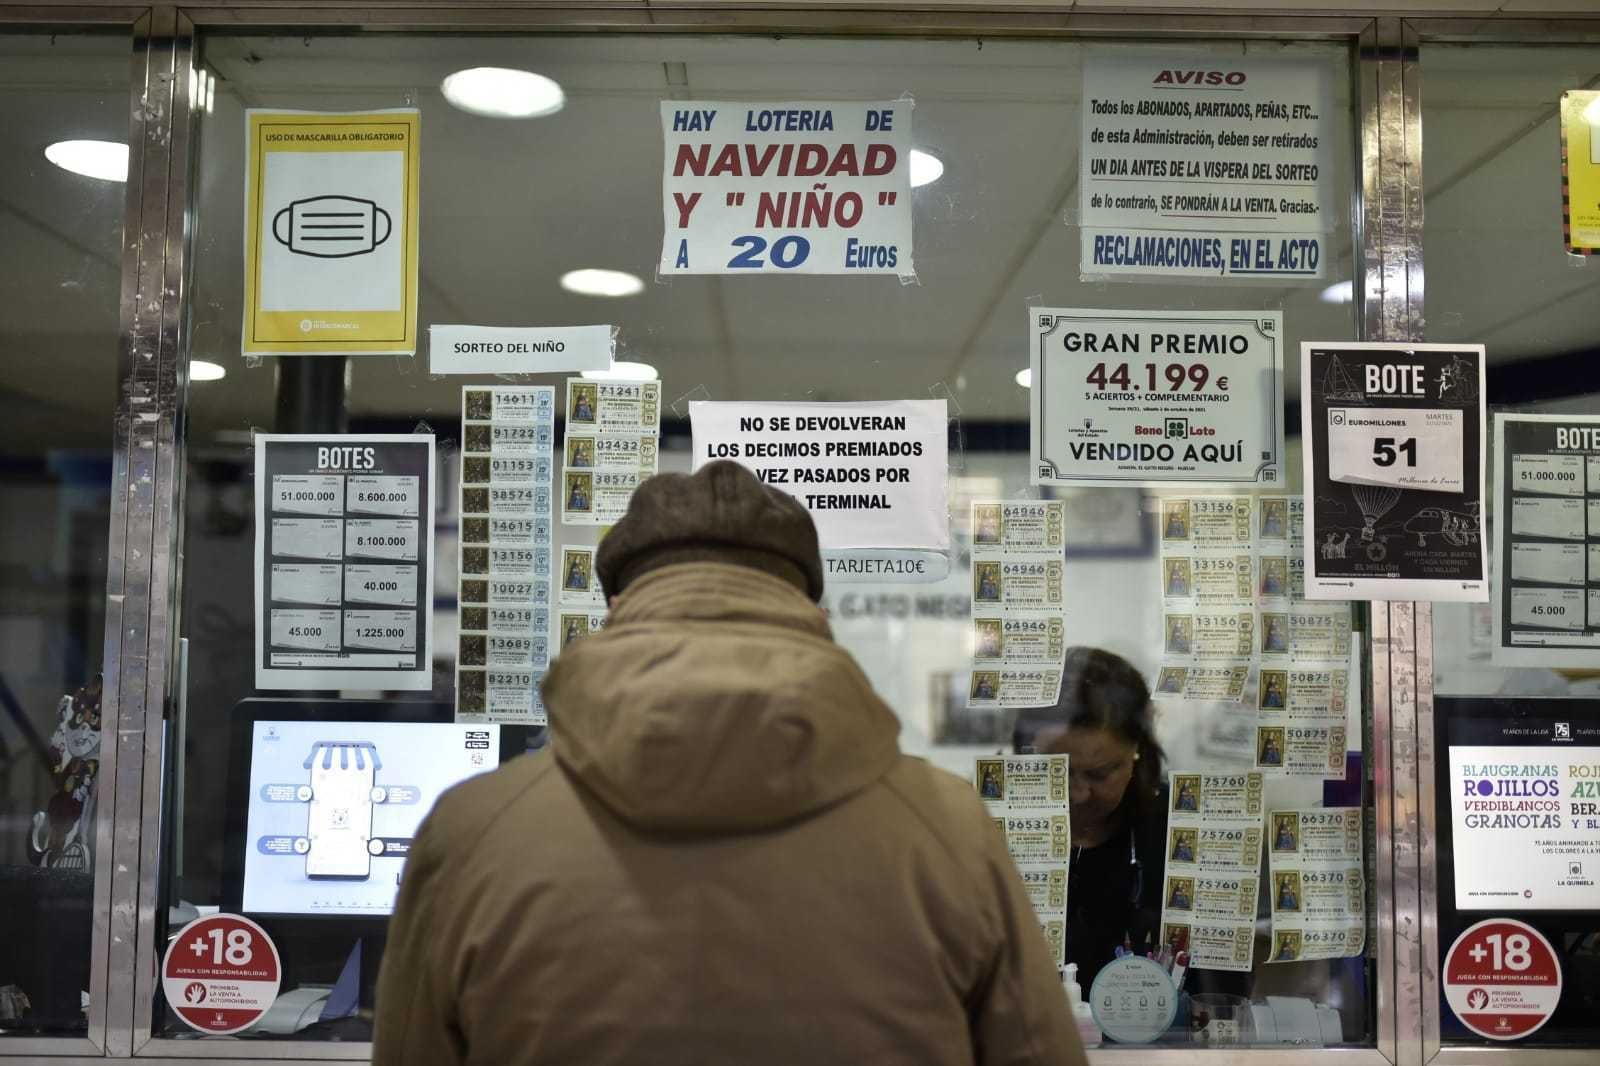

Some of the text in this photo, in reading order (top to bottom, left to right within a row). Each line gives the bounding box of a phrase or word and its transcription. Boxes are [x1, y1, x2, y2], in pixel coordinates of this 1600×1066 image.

[1153, 70, 1246, 85] AVISO
[1092, 100, 1318, 121] Todos los ABONADOS, APARTADOS, PEÑAS, ETC...
[673, 110, 893, 131] HAY LOTERIA DE
[1091, 128, 1318, 149] de esta Administración, deben ser retirados
[673, 144, 897, 176] NAVIDAD
[1091, 159, 1318, 181] UN DIA ANTES DE LA VISPERA DEL SORTEO
[673, 193, 702, 228] Y
[755, 183, 864, 228] NIÑO
[1091, 194, 1102, 208] de
[1104, 194, 1113, 208] lo
[1115, 195, 1158, 212] contrario,
[1161, 196, 1172, 210] SE
[1174, 193, 1219, 211] PONDRÁN
[1221, 198, 1228, 211] A
[1230, 198, 1241, 212] LA
[1244, 198, 1277, 212] VENTA.
[676, 236, 897, 268] A 20 Euros
[1094, 235, 1319, 275] RECLAMACIONES, EN EL ACTO
[454, 339, 565, 354] SORTEO DEL NIÑO
[1064, 333, 1249, 354] GRAN PREMIO
[1086, 363, 1228, 391] 44.199 €
[1365, 365, 1425, 393] BOTE
[600, 387, 639, 397] 71241
[496, 394, 534, 405] 14611
[1092, 393, 1135, 401] ACIERTOS
[1144, 393, 1230, 402] COMPLEMENTARIO
[740, 417, 906, 431] NO SE DEVOLVERAN
[494, 429, 535, 439] 91722
[1135, 426, 1215, 436] Bono Loto
[597, 441, 637, 450] 02432
[708, 442, 923, 457] LOS DECIMOS PREMIADOS
[1070, 440, 1243, 463] VENDIDO AQUÍ
[1372, 438, 1416, 467] 51
[318, 447, 374, 469] BOTES
[492, 461, 533, 471] 01153
[596, 476, 636, 484] 38574
[756, 468, 910, 483] VEZ PASADOS POR
[1521, 471, 1575, 481] 51.000.000
[281, 491, 407, 502] 51.000.000 8.600.000
[492, 491, 532, 500] 38574
[806, 495, 891, 509] TERMINAL
[1004, 507, 1044, 516] 64946
[1194, 503, 1233, 512] 13156
[493, 522, 532, 531] 14615
[357, 536, 406, 546] 8.100.000
[492, 551, 532, 560] 13156
[826, 558, 925, 574] TARJETA10€
[1004, 565, 1044, 574] 64946
[1194, 560, 1234, 569] 13156
[364, 582, 397, 591] 40.000
[492, 584, 531, 594] 10027
[491, 611, 531, 620] 14618
[1531, 606, 1565, 616] 45.000
[1196, 618, 1236, 626] 13156
[1290, 617, 1332, 625] 50875
[1005, 622, 1046, 632] 64946
[289, 627, 404, 638] 45.000 1.225.000
[490, 639, 531, 648] 13689
[489, 675, 529, 685] 82210
[1007, 762, 1048, 772] 96532
[1463, 765, 1558, 776] BLAUGRANAS
[1204, 778, 1245, 787] 75760
[1464, 780, 1559, 796] ROJILLOS
[1465, 801, 1560, 811] VERDIBLANCOS
[1009, 820, 1049, 830] 96532
[1465, 815, 1561, 829] GRANOTAS
[1572, 820, 1579, 828] Y
[1201, 832, 1242, 840] 75760
[1302, 874, 1343, 882] 66370
[1198, 881, 1238, 889] 75760
[1194, 928, 1234, 937] 75760
[1304, 933, 1345, 942] 66370
[190, 928, 252, 966] +18
[1469, 934, 1532, 971] +18
